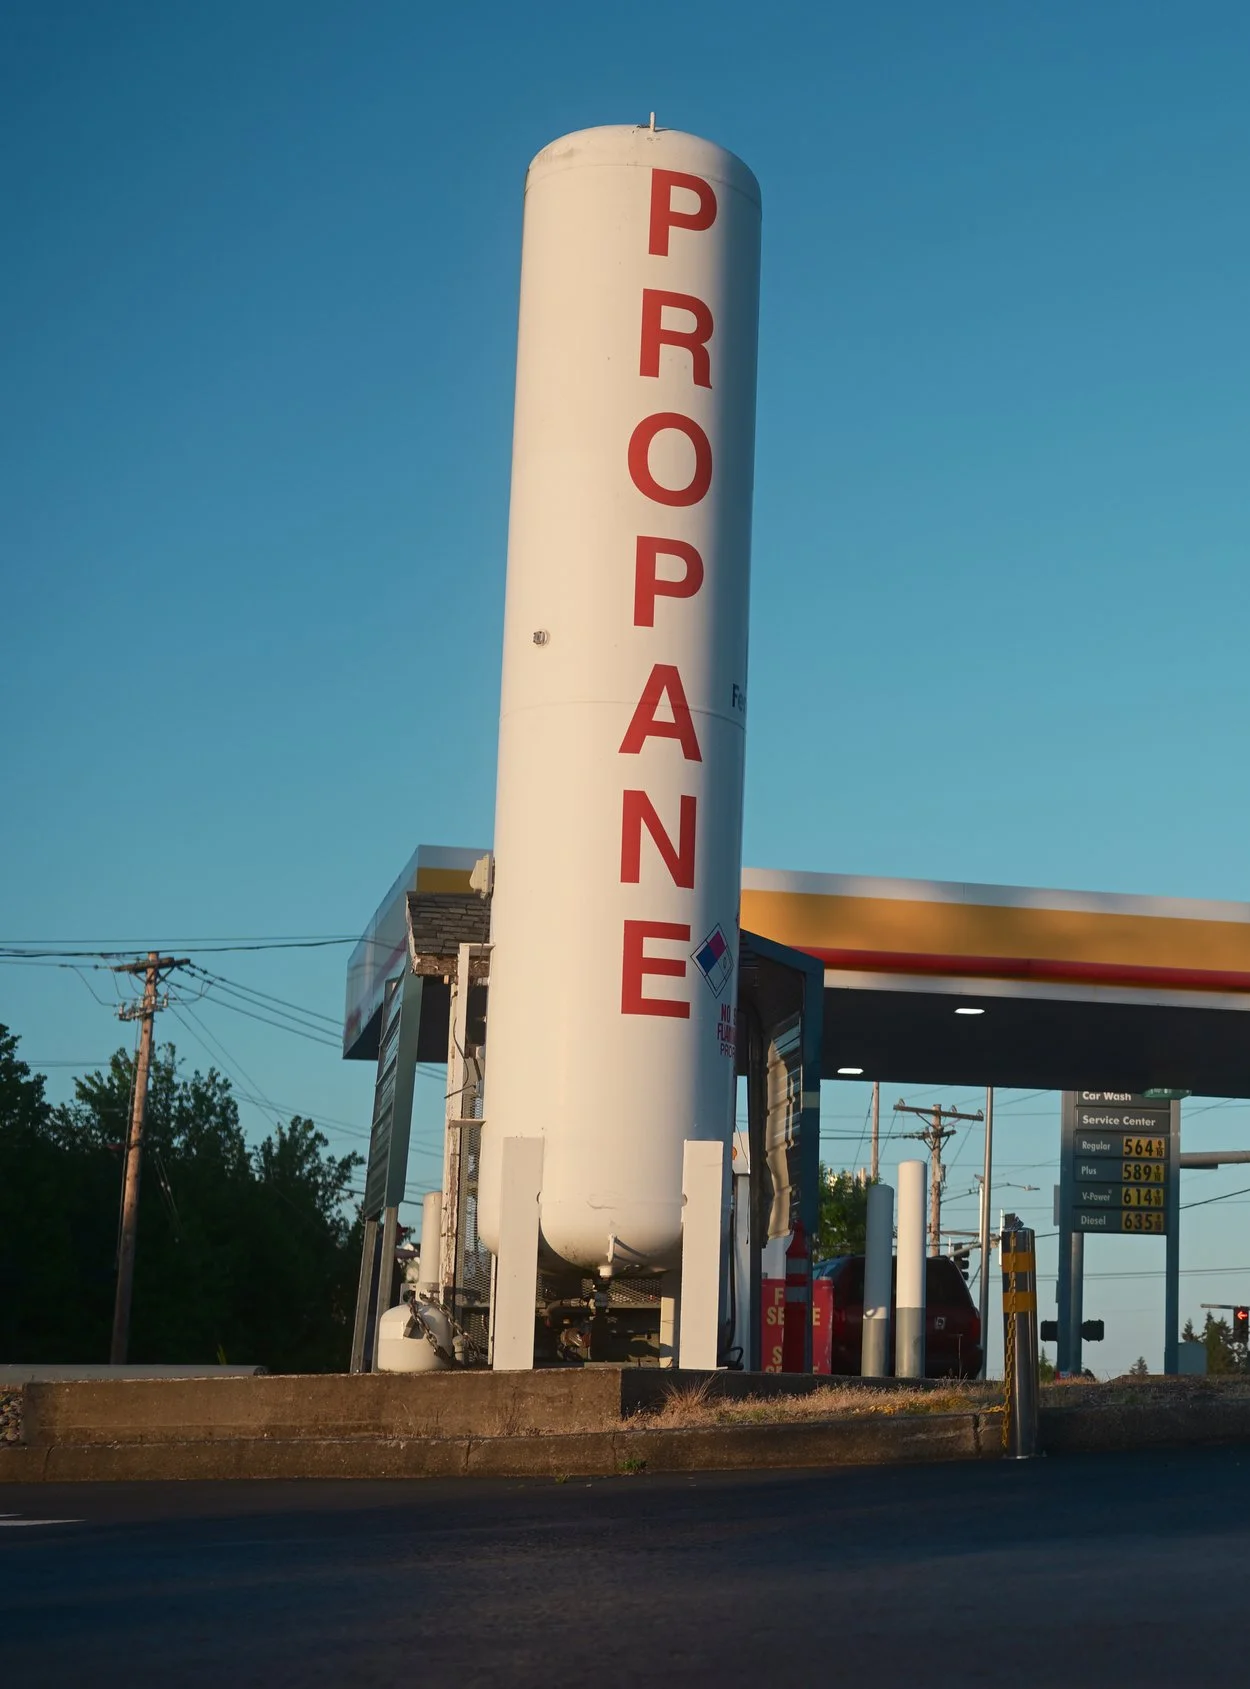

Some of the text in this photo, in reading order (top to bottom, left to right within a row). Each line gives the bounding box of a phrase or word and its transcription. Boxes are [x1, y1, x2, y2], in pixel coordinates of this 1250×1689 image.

[618, 168, 718, 1019] PROPANE
[1082, 1090, 1132, 1102] Car Wash
[1082, 1114, 1156, 1127] Service Center
[1082, 1140, 1111, 1151] Regular
[1124, 1138, 1154, 1157] 564
[1081, 1166, 1097, 1175] Plus
[1123, 1164, 1152, 1181] 589
[1123, 1188, 1153, 1206] 614
[1080, 1215, 1106, 1225] Diesel
[1124, 1212, 1153, 1231] 635
